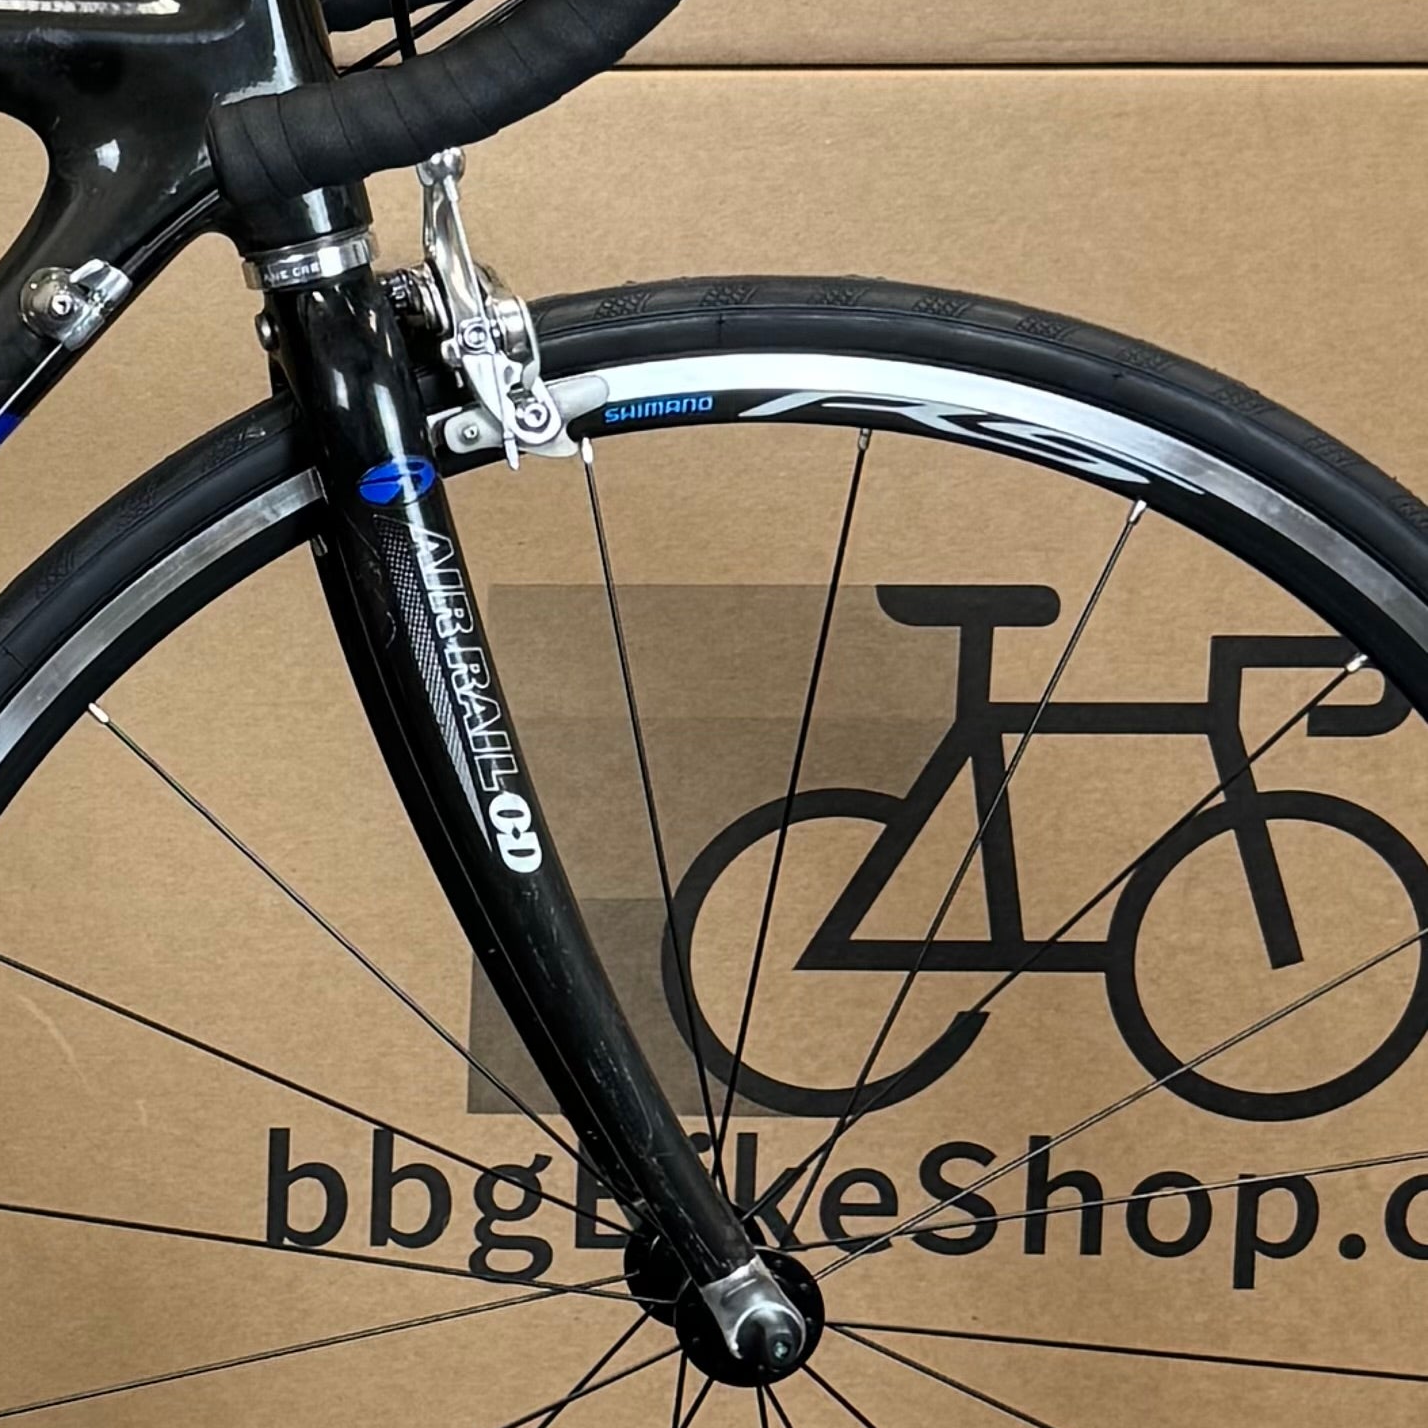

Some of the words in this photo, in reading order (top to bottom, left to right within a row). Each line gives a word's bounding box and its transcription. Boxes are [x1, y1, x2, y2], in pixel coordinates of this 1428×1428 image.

[604, 395, 714, 423] SHIMANO
[410, 524, 474, 639] AIR
[444, 646, 521, 793] RAIL
